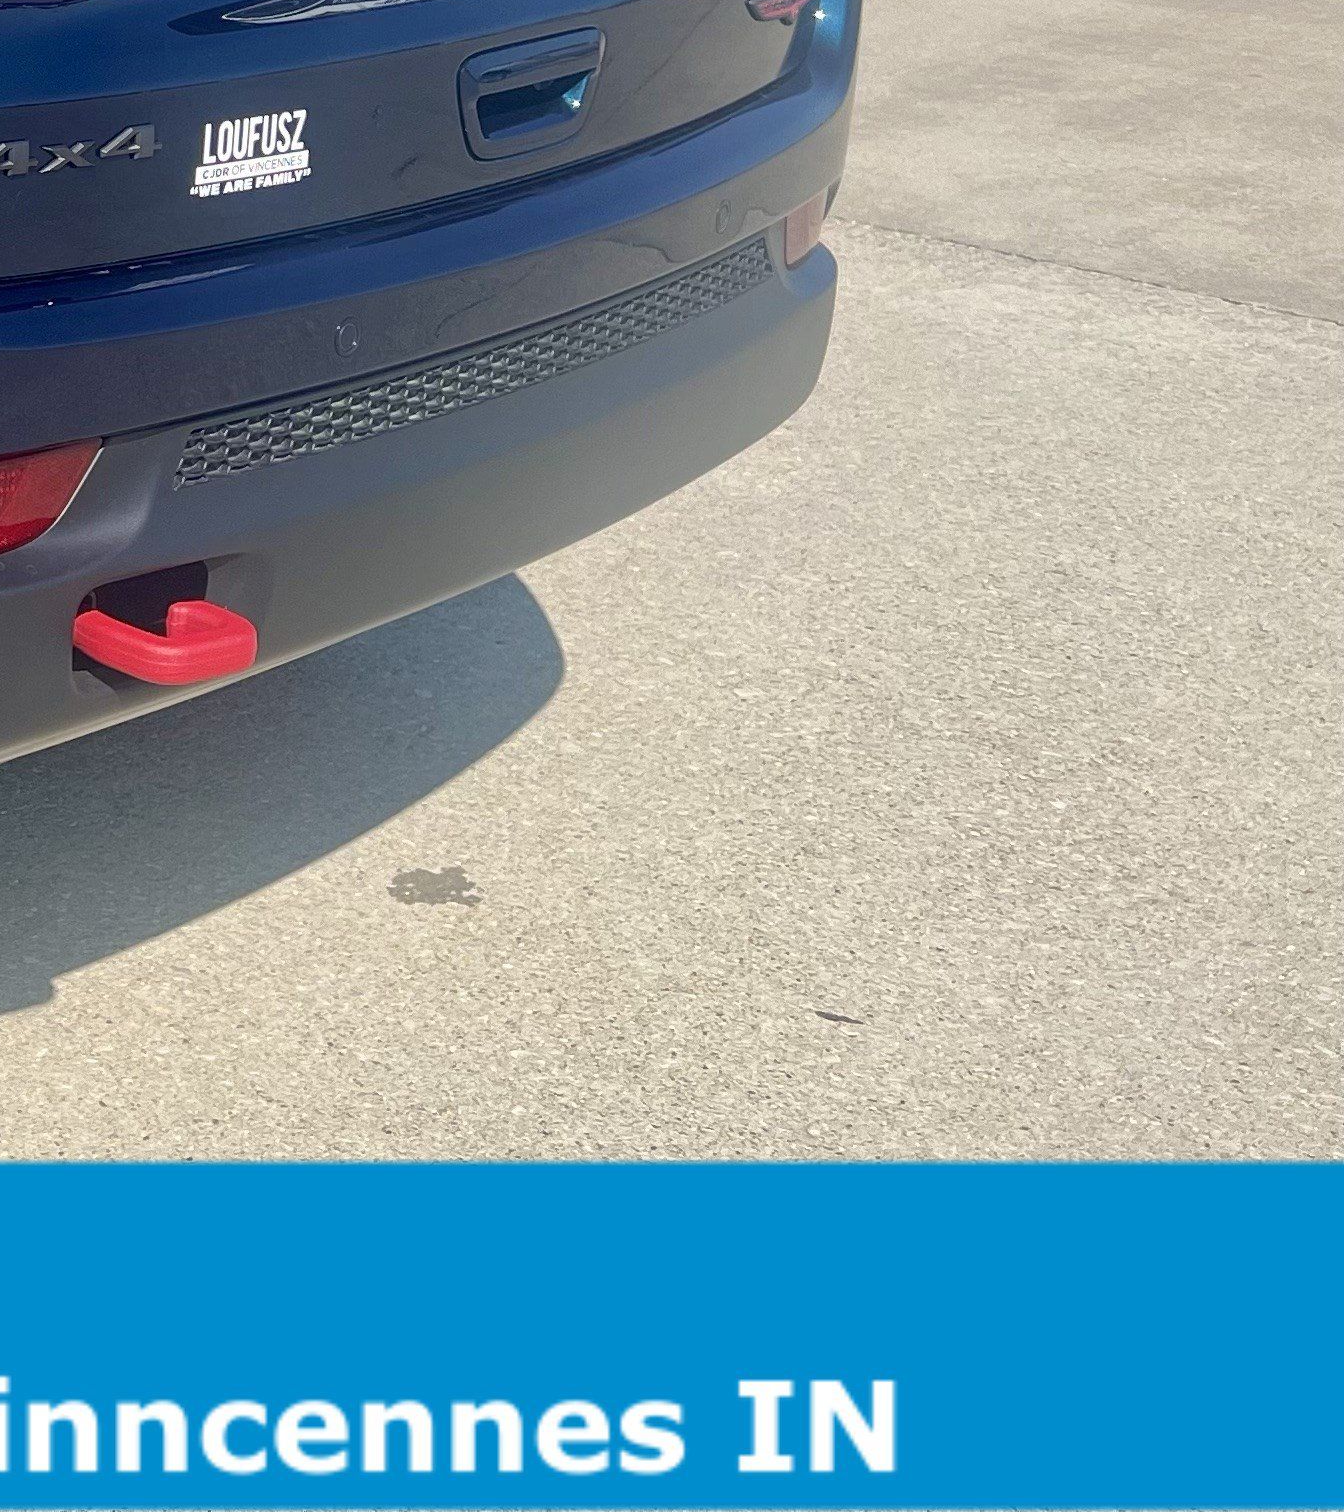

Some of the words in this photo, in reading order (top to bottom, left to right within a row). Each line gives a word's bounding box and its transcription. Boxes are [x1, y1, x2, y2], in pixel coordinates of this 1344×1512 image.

[202, 168, 229, 180] CJDR
[232, 164, 246, 176] OF
[248, 155, 303, 173] VINCENNES
[222, 177, 253, 194] ARE
